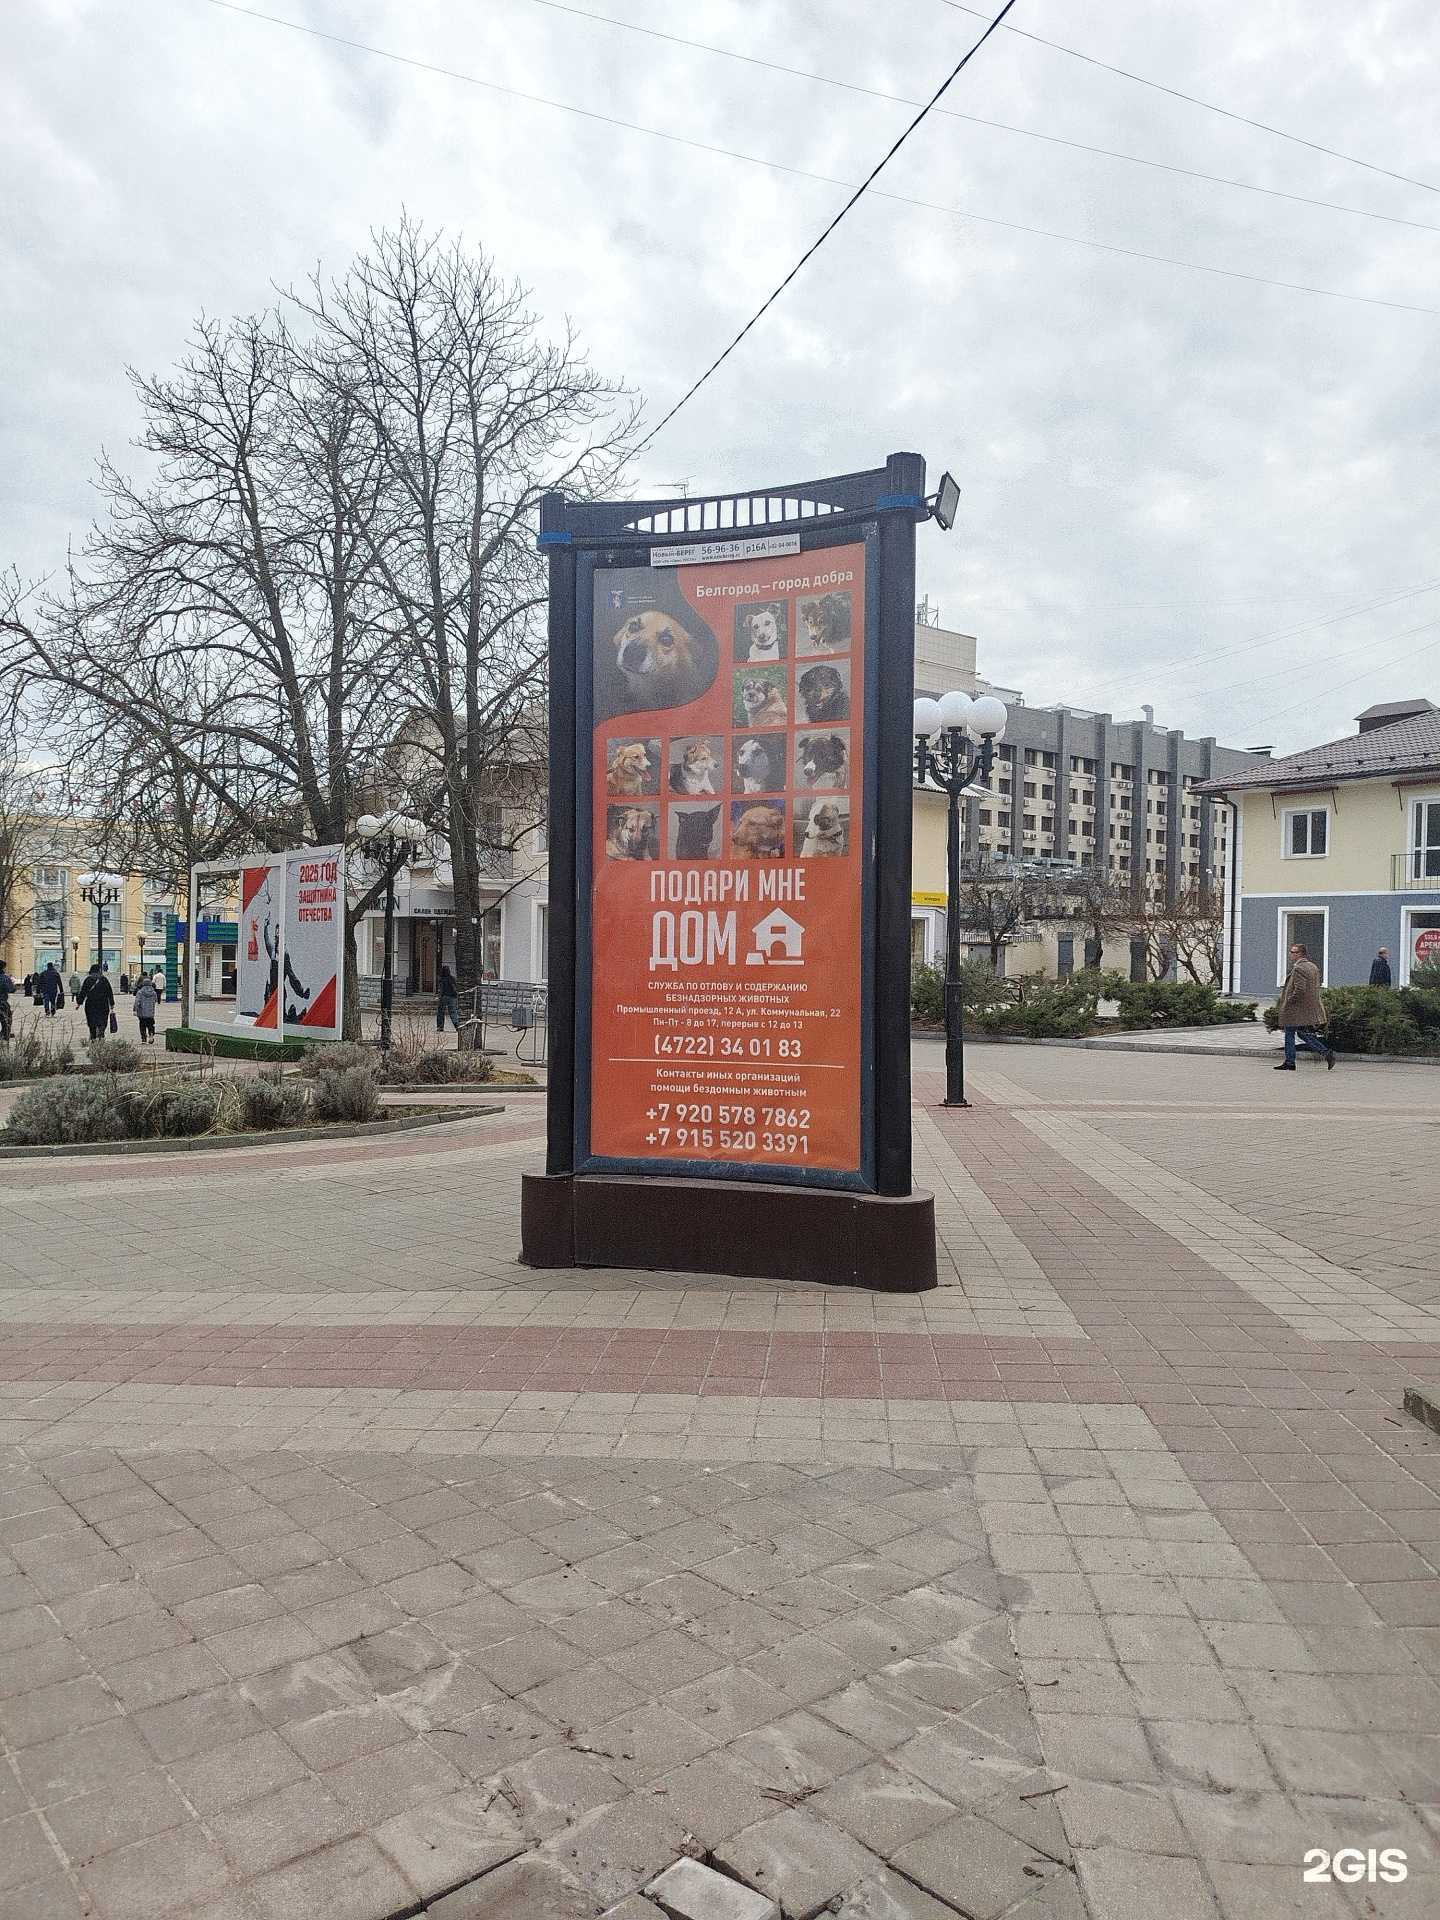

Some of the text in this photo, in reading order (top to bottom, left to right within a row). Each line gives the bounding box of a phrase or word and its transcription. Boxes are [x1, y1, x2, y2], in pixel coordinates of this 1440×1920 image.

[702, 544, 740, 554] 56-96-36
[696, 583, 760, 598] Белгород
[772, 577, 810, 592] город
[813, 570, 854, 587] добра
[299, 862, 338, 884] 2025 ГОД
[650, 868, 806, 905] ПОДАРИ МНЕ
[298, 907, 333, 922] ОТЕЧЕСТВА
[649, 910, 737, 972] ДОМ
[648, 982, 808, 992] СЛУЖБА ПО ОТЛОВУ И СОДЕРЖАНИЮ
[665, 993, 790, 1004] БЕЗНАДЗОРНЫХ ЖИВОТНЫХ
[616, 1004, 687, 1014] Промышленный
[724, 1006, 734, 1015] 12
[746, 1008, 758, 1017] ул.
[760, 1008, 828, 1018] Коммунальная,
[830, 1008, 840, 1018] 22
[654, 1018, 678, 1026] Пн-Пт
[686, 1018, 692, 1026] 8
[694, 1019, 704, 1028] до
[707, 1019, 719, 1028] 17,
[721, 1021, 759, 1029] перерыв
[768, 1020, 778, 1029] 12
[780, 1021, 791, 1030] до
[793, 1021, 803, 1030] 13
[654, 1034, 802, 1058] (4722) 34 01 83
[656, 1068, 801, 1083] Контакты иных организаций
[650, 1084, 807, 1097] помощи бездомным животным
[646, 1103, 811, 1129] +7 920 578 7862
[646, 1127, 808, 1154] +7 915 520 3391
